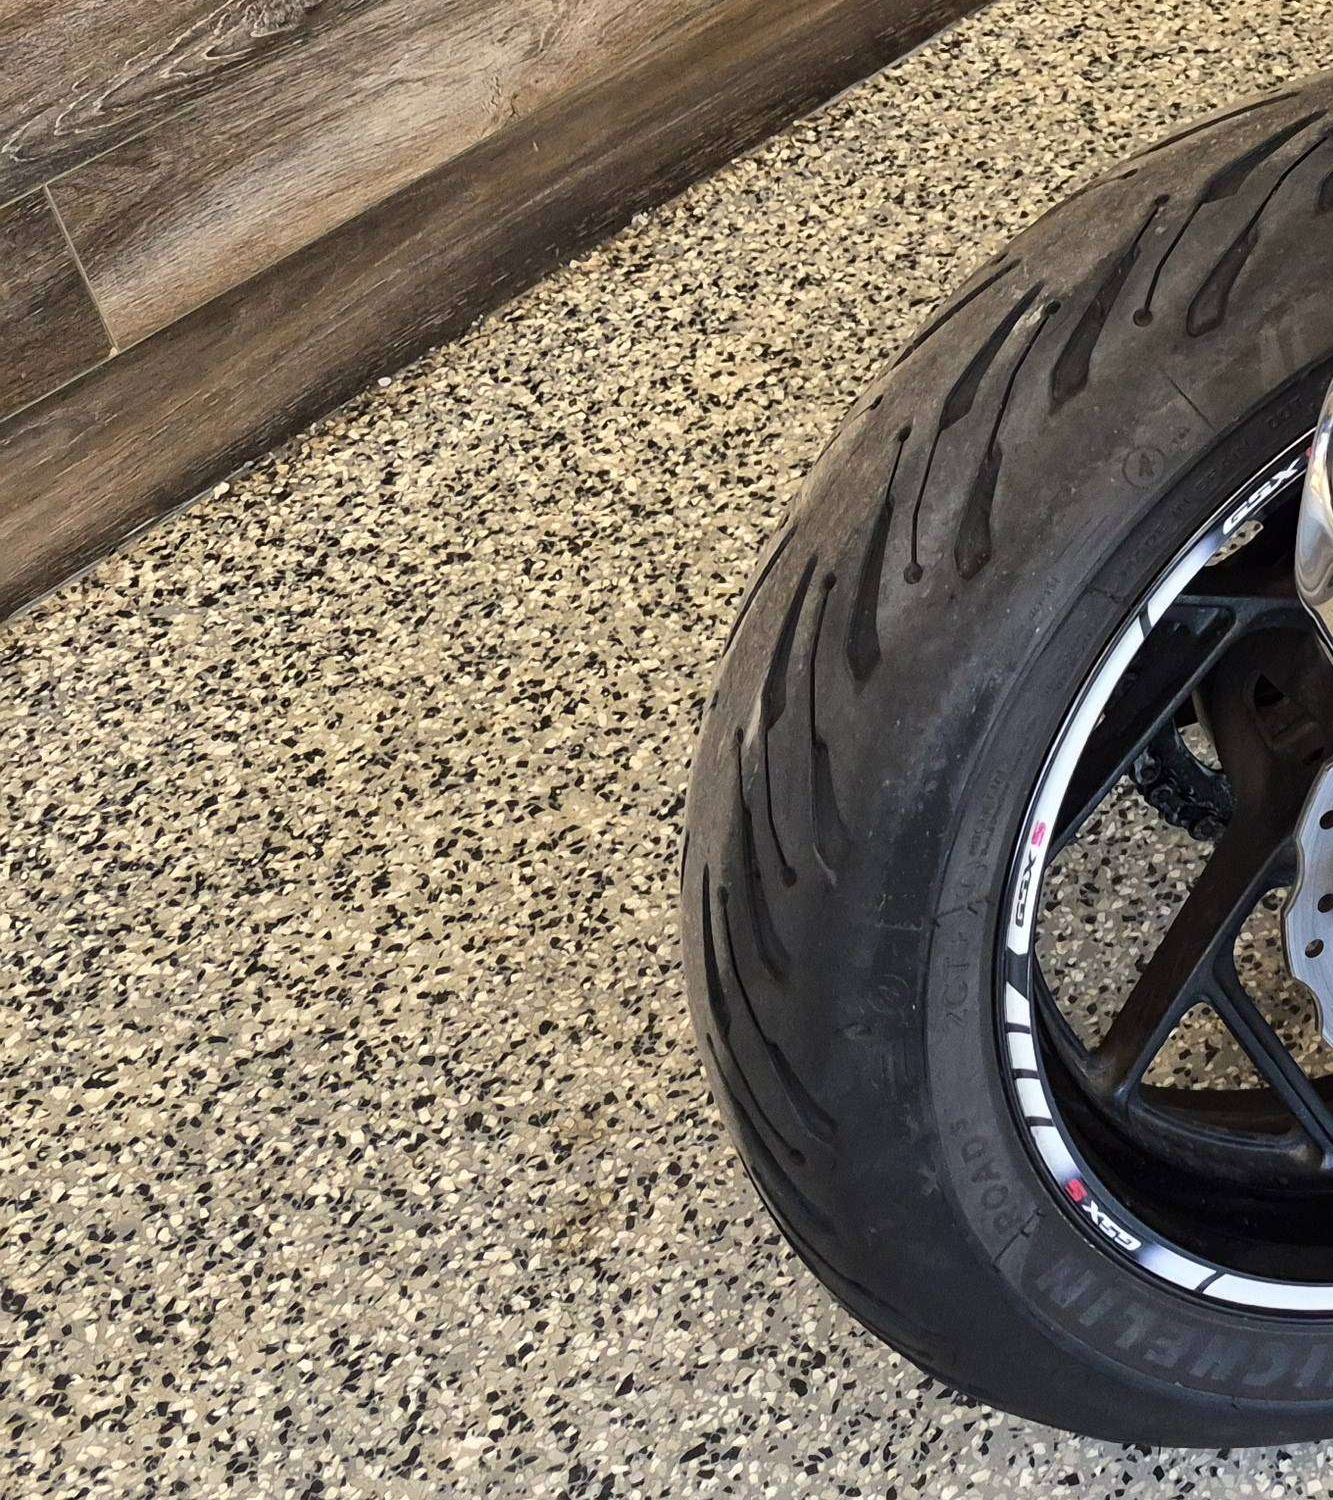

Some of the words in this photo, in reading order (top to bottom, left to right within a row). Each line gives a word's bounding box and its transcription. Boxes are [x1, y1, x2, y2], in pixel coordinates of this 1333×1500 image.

[1222, 456, 1301, 535] GSX
[1014, 849, 1037, 928] GSX
[1081, 1200, 1142, 1251] GSX
